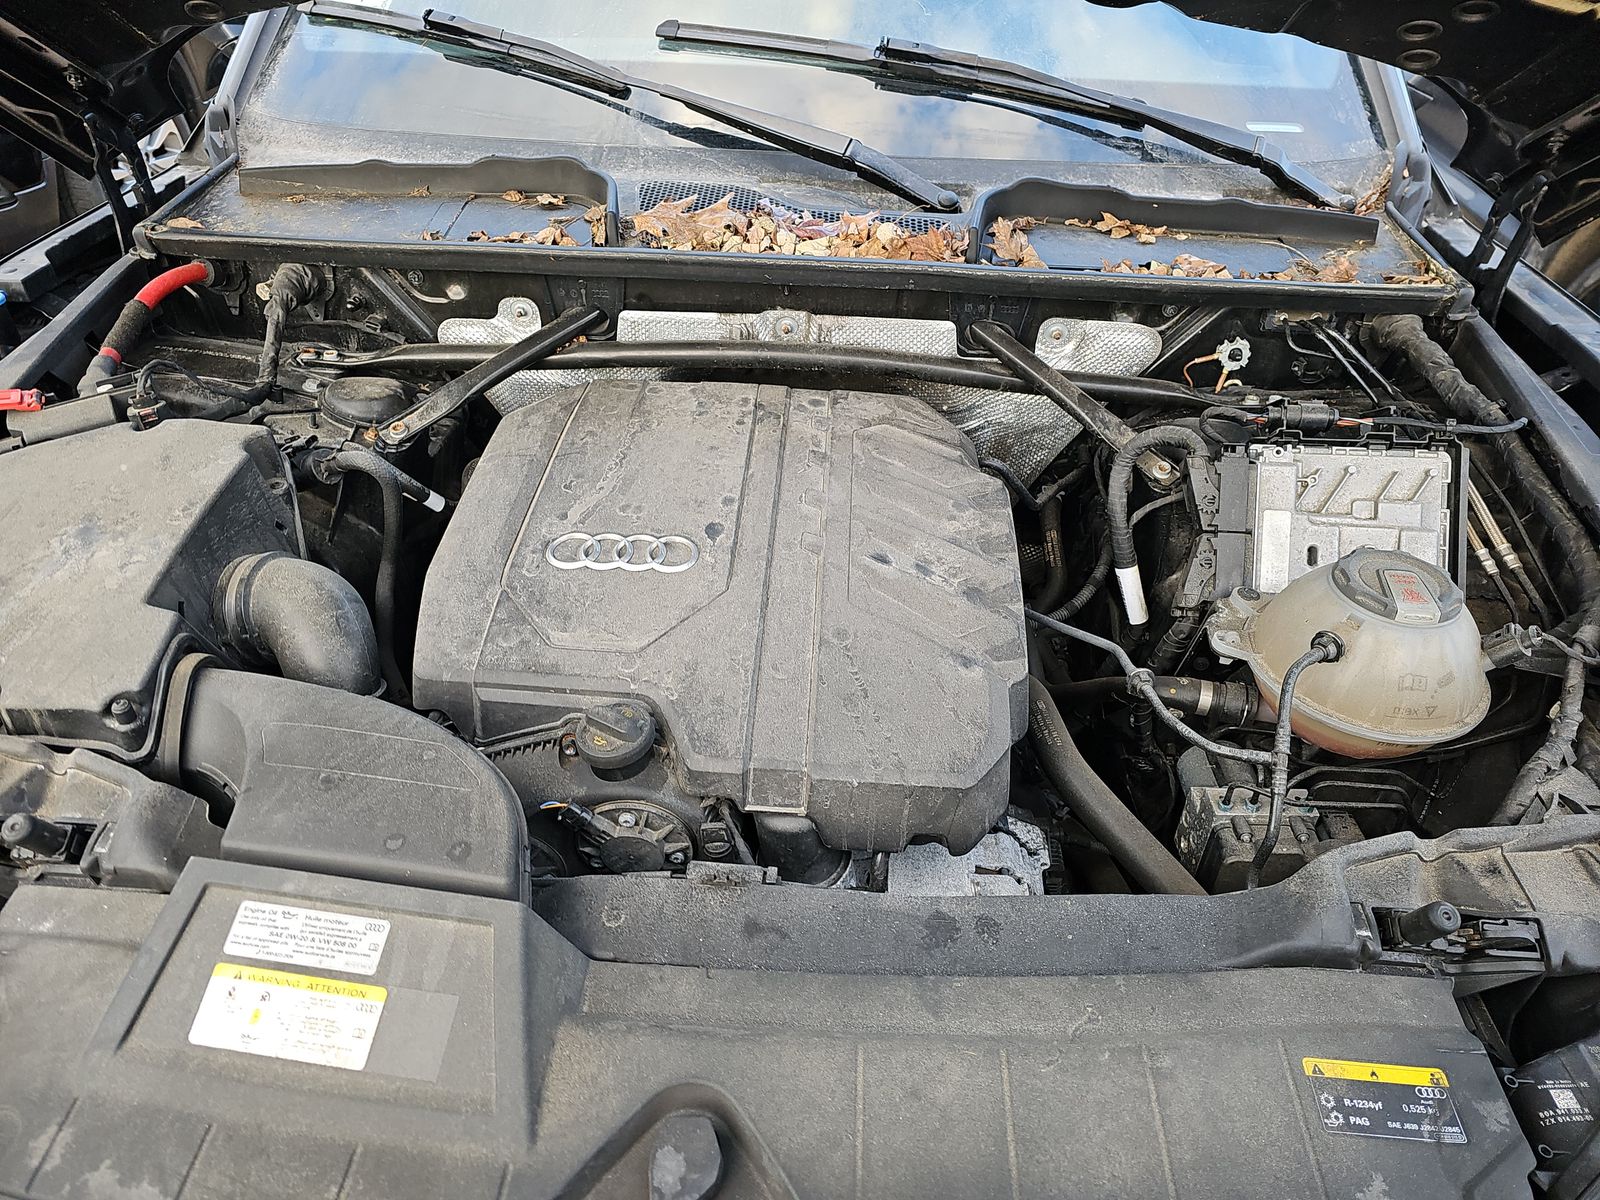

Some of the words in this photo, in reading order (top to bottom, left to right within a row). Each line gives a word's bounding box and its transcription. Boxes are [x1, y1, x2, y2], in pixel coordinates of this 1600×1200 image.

[244, 906, 266, 914] Engine
[305, 914, 322, 922] Huile
[323, 918, 349, 926] moteur
[285, 933, 309, 942] 0W-20
[318, 937, 332, 945] VW
[248, 974, 300, 988] WARNING
[307, 982, 368, 999] ATTENTION
[1343, 1098, 1383, 1111] R-1234yf
[1402, 1103, 1427, 1114] 0,525
[1349, 1116, 1371, 1126] PAG
[1387, 1121, 1402, 1129] SAE
